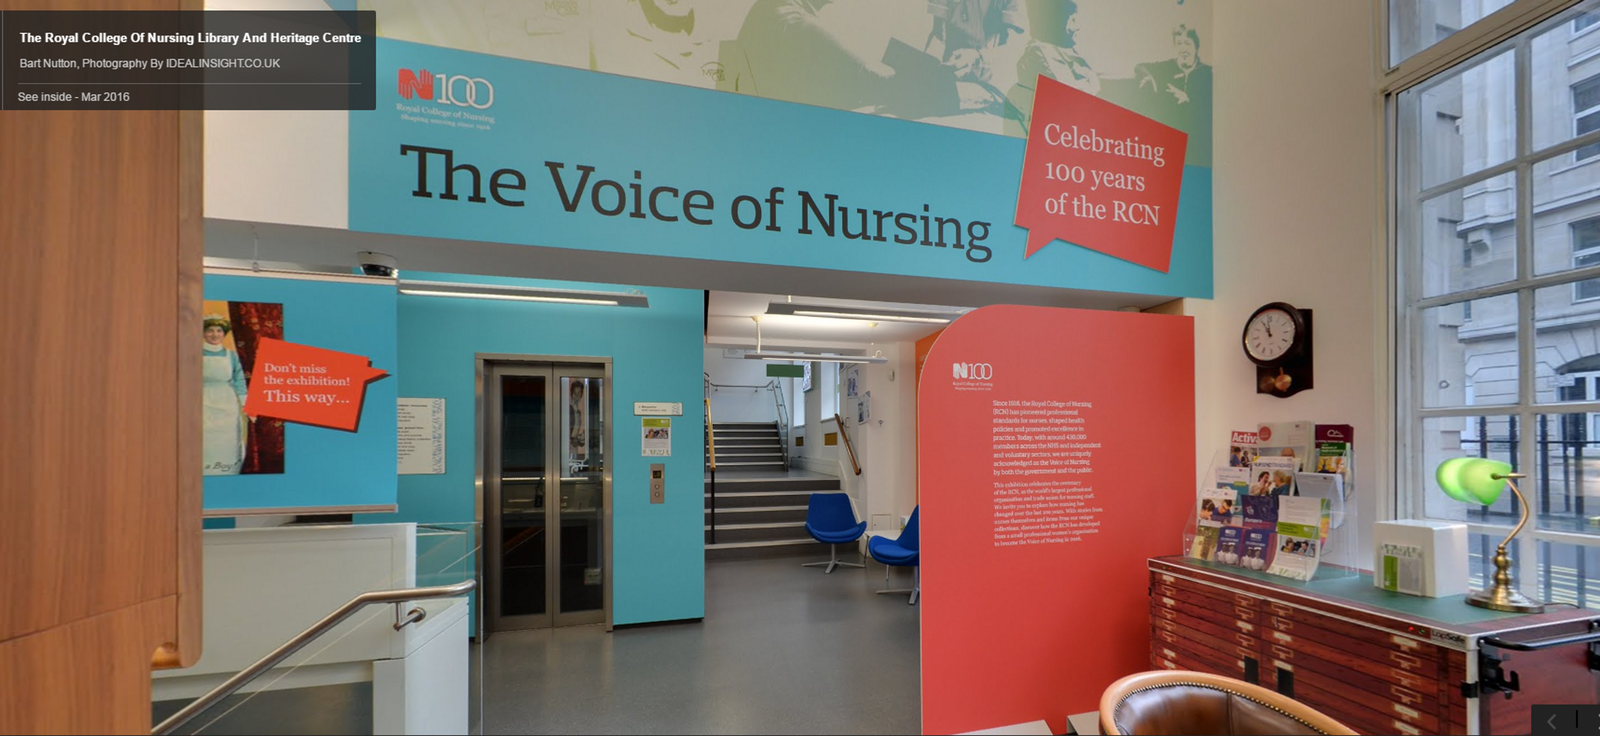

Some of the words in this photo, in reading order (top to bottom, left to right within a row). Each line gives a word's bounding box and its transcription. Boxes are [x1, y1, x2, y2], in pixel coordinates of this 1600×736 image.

[396, 103, 420, 115] Royal
[422, 106, 452, 118] College
[453, 110, 462, 118] of
[463, 112, 496, 124] Nursing
[401, 114, 429, 124] Shaping
[430, 118, 456, 127] nursing
[1044, 123, 1165, 168] Celebrating
[1046, 162, 1085, 184] 100
[1091, 168, 1145, 192] years
[400, 144, 526, 206] The
[544, 161, 714, 225] Voice
[730, 188, 784, 232] of
[798, 190, 992, 263] Nursing
[1045, 193, 1068, 216] of
[1072, 195, 1106, 220] the
[1112, 200, 1160, 226] RCN
[264, 363, 297, 373] Don't
[300, 364, 326, 374] miss
[264, 375, 284, 384] the
[286, 376, 350, 386] exhibition!
[264, 390, 300, 402] This
[304, 394, 350, 406] way...
[1432, 629, 1466, 644] LapSafe
